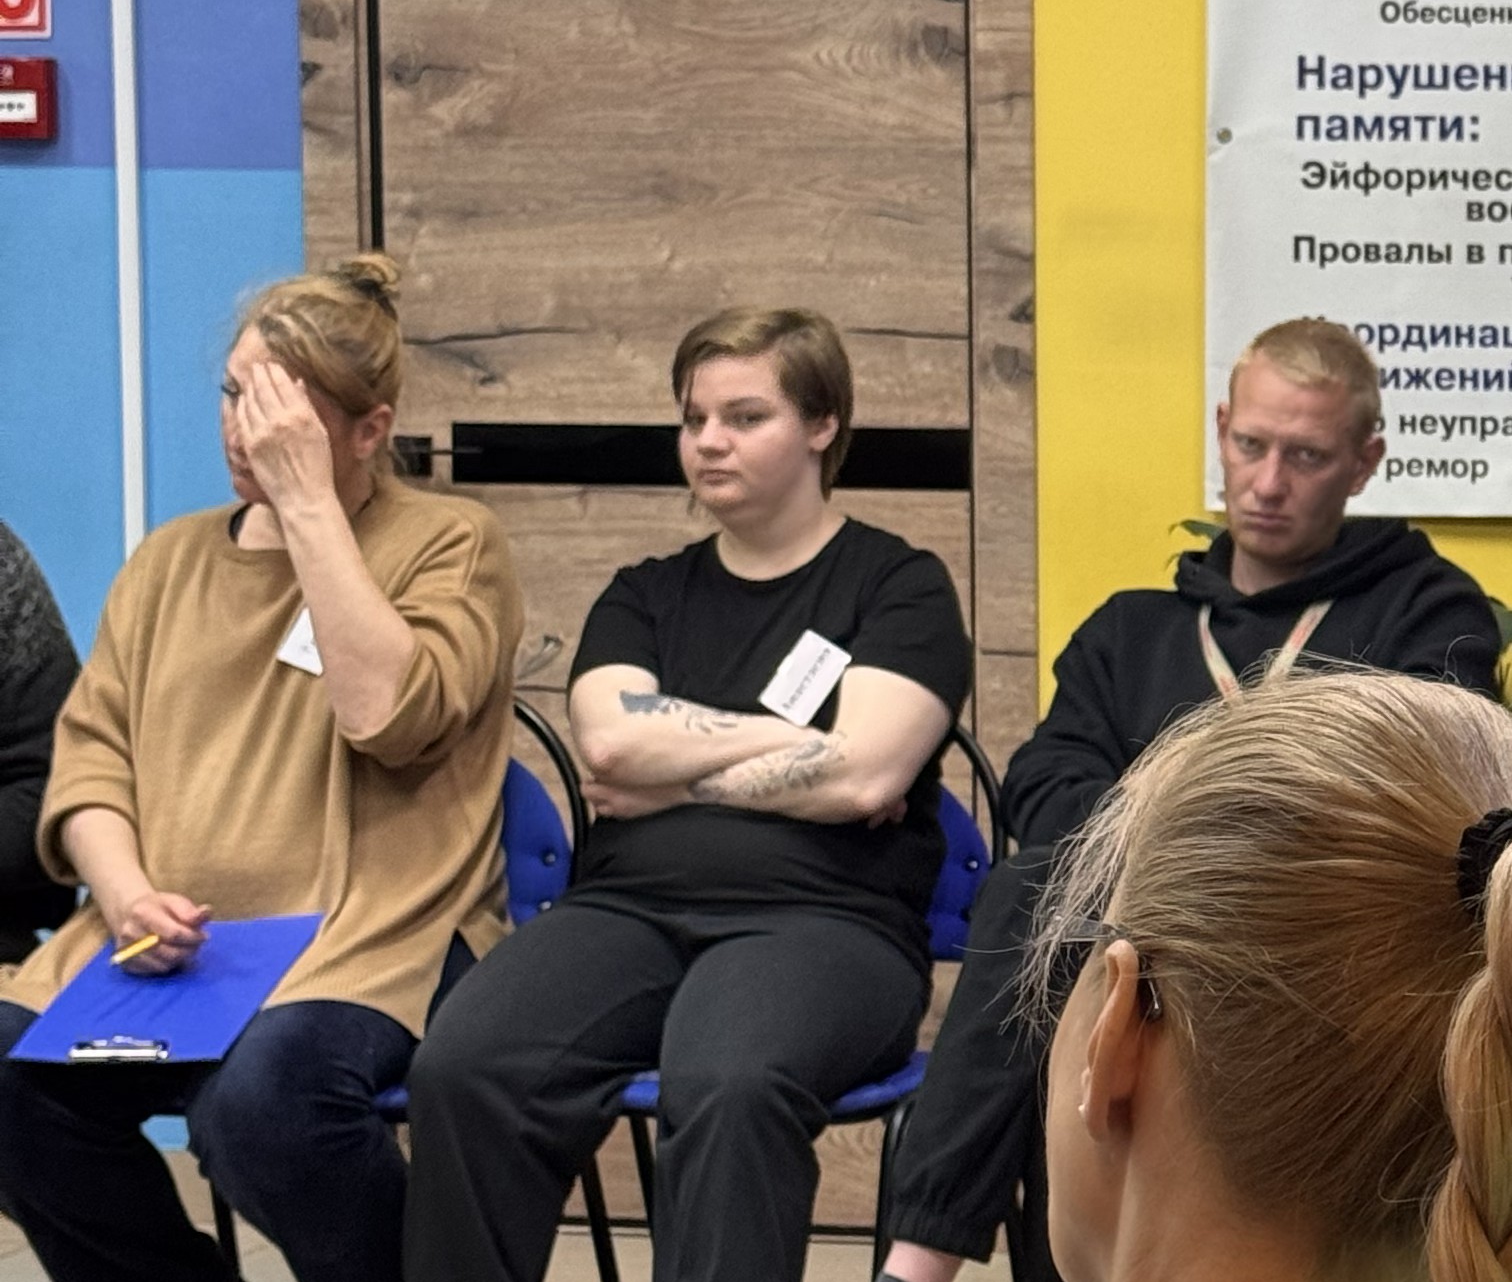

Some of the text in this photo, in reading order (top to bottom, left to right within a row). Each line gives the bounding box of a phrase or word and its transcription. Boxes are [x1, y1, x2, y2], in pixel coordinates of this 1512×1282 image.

[1297, 115, 1479, 141] памяти:
[1294, 235, 1452, 268] Провалы
[1467, 244, 1485, 264] в
[1386, 455, 1489, 483] ремор
